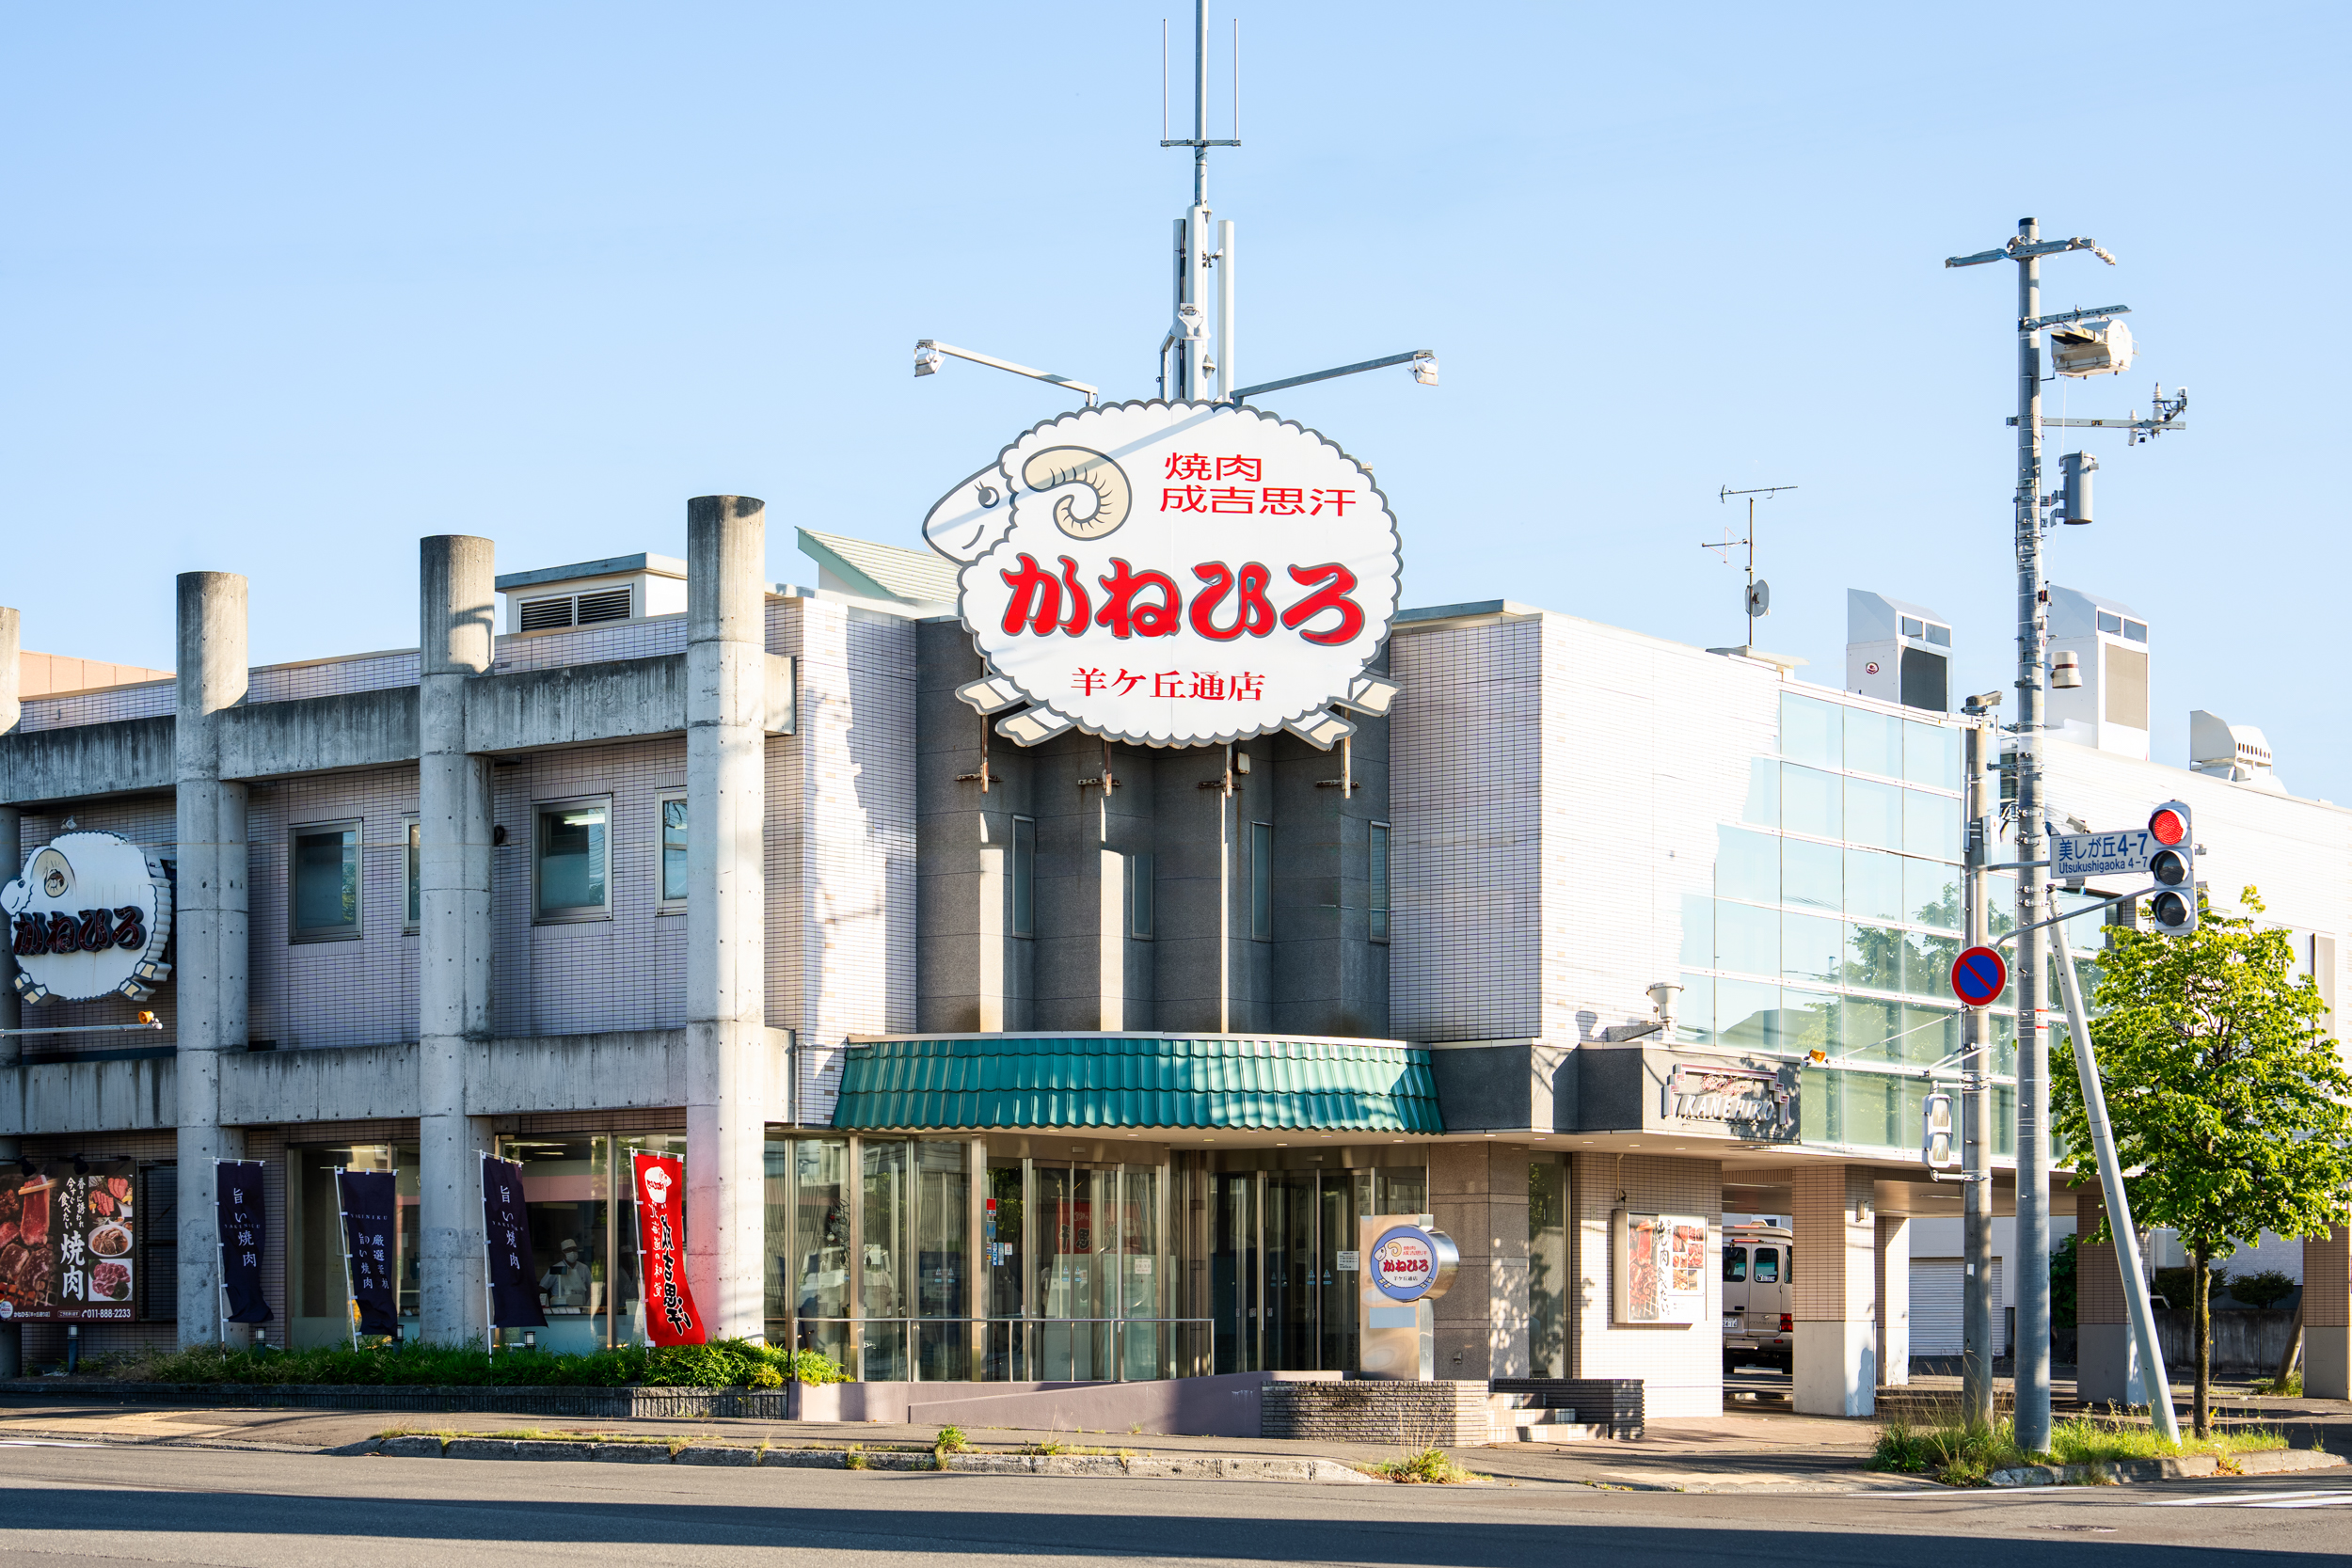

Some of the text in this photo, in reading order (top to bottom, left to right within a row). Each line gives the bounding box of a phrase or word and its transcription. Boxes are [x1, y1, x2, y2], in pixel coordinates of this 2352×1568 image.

[1164, 452, 1263, 483] 焼肉
[1159, 483, 1357, 517] 成吉思汗
[999, 552, 1364, 647] かねひろ
[2058, 856, 2148, 875] Utsukushigaoka 4-7
[13, 905, 147, 957] かねひろ
[1679, 1094, 1774, 1121] KANEHIRO
[233, 1187, 257, 1268] 旨い焼肉
[500, 1185, 520, 1270] 旨い焼肉
[60, 1229, 86, 1302] 焼肉
[1383, 1259, 1429, 1273] かねひろ
[87, 1308, 131, 1318] 011-888-2233
